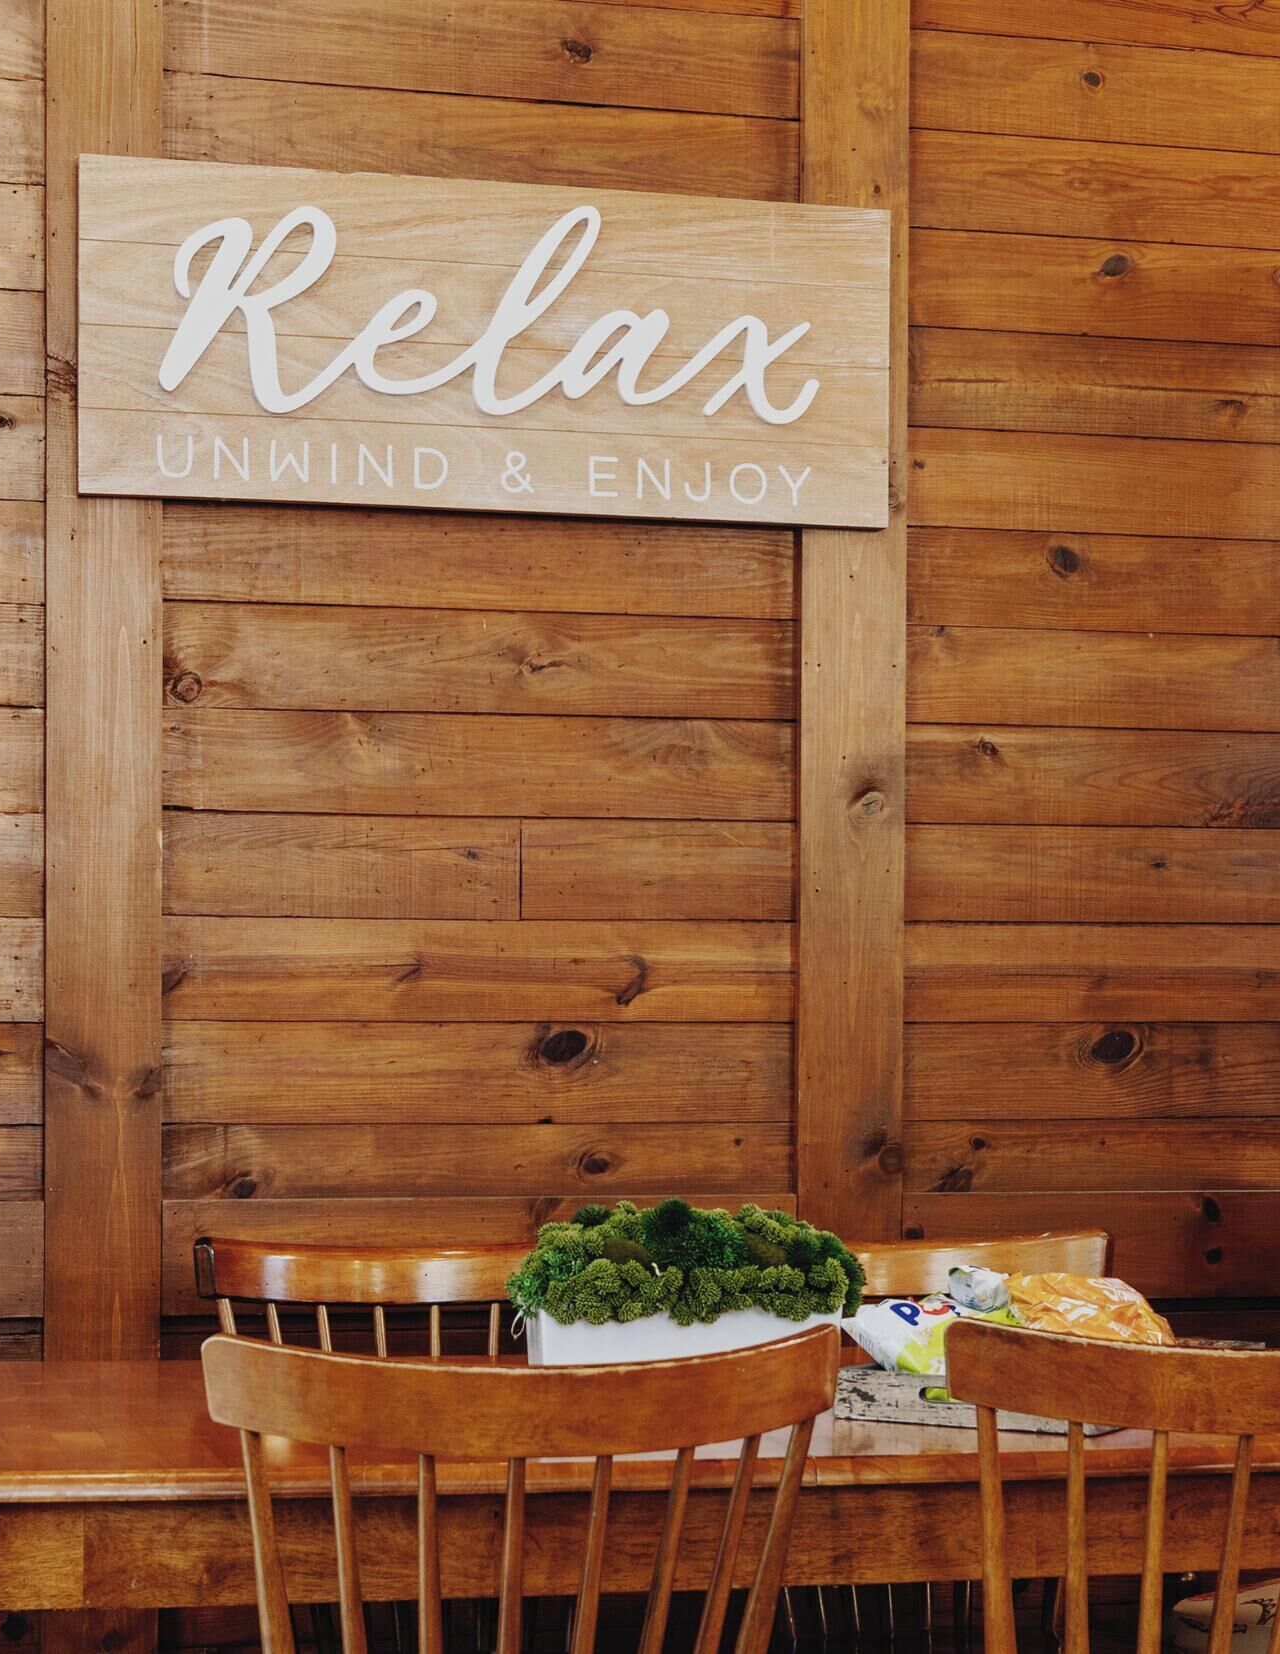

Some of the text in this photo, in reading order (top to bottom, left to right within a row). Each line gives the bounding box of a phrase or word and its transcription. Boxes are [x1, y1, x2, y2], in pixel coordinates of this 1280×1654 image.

[158, 204, 821, 425] Relax
[156, 433, 813, 508] UNWIND & ENJOY
